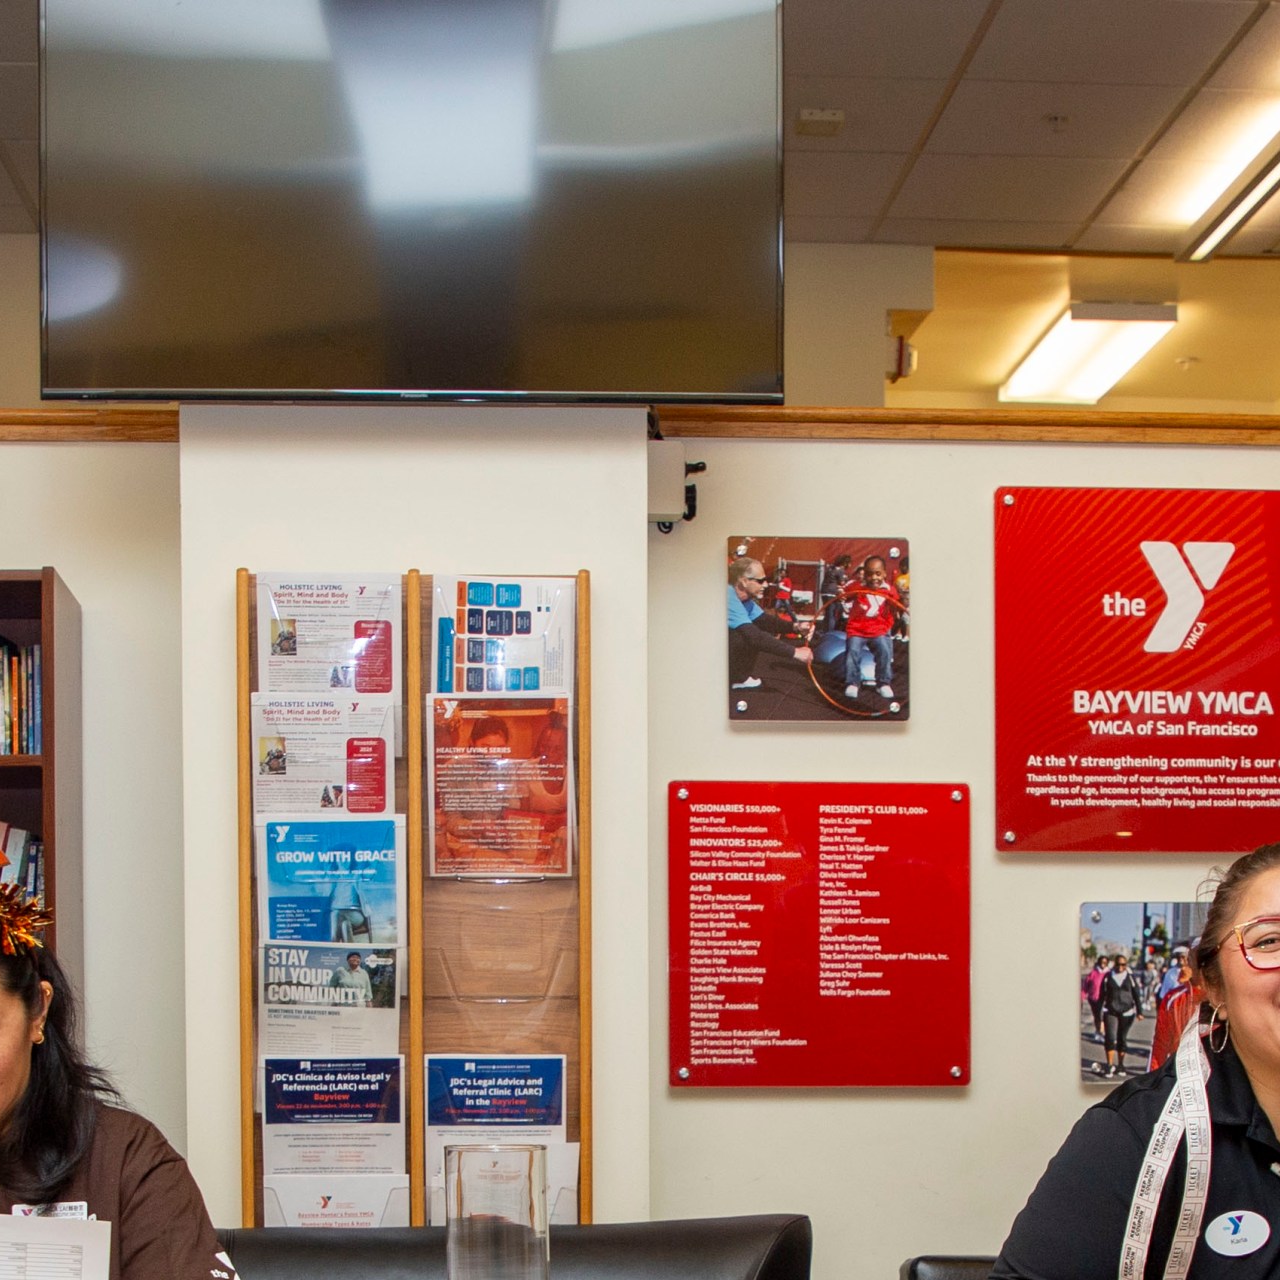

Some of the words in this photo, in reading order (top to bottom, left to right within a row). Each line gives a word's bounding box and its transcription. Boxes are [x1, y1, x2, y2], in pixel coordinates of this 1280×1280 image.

[1103, 592, 1145, 616] the
[1140, 541, 1235, 653] Y
[1184, 621, 1207, 650] YMCA
[1073, 690, 1192, 714] BAYVIEW
[1197, 691, 1274, 715] YMCA
[1089, 721, 1134, 735] YMCA
[1137, 721, 1154, 735] of
[1157, 721, 1184, 735] San
[1188, 722, 1257, 736] Francisco
[1027, 756, 1042, 766] At
[1045, 756, 1066, 767] the
[1069, 756, 1078, 767] Y
[1081, 756, 1168, 770] strengthening
[1171, 756, 1238, 770] community
[1240, 757, 1251, 768] is
[1254, 759, 1276, 768] our
[1027, 774, 1057, 783] Thanks
[1058, 774, 1068, 783] to
[1069, 774, 1083, 783] the
[1084, 774, 1128, 785] generosity
[1129, 774, 1138, 783] of
[1156, 775, 1202, 786] supporters,
[1204, 775, 1217, 784] the
[1218, 776, 1226, 784] Y
[1227, 776, 1258, 784] ensures
[1260, 776, 1277, 784] that
[1026, 786, 1070, 796] regardless
[1071, 786, 1080, 794] of
[1081, 788, 1098, 796] age,
[1100, 786, 1129, 795] income
[1141, 786, 1191, 797] background,
[1192, 786, 1207, 795] has
[1236, 787, 1245, 795] to
[690, 804, 744, 812] VISIONARIES
[1051, 798, 1059, 806] in
[1060, 798, 1084, 808] youth
[1086, 798, 1140, 808] development,
[1142, 798, 1172, 808] healthy
[1173, 798, 1196, 809] living
[1197, 798, 1212, 807] and
[1213, 798, 1236, 807] social
[819, 805, 874, 814] PRESIDENT'S
[875, 806, 896, 814] CLUB
[898, 807, 928, 815] $1,000+
[276, 851, 314, 863] GROW
[318, 851, 350, 862] WITH
[355, 850, 395, 861] GRACE
[690, 873, 723, 881] CHAIR'S
[725, 873, 753, 881] CIRCLE
[269, 948, 309, 966] STAY
[269, 967, 285, 983] IN
[268, 985, 365, 1003] COMMUNITY
[272, 1074, 293, 1083] JDC's
[325, 1073, 335, 1081] de
[337, 1073, 360, 1081] Aviso
[362, 1073, 383, 1082] Legal
[450, 1078, 471, 1087] JDC's
[473, 1078, 495, 1087] Legal
[283, 1083, 328, 1091] Referencia
[330, 1083, 357, 1091] (LARC)
[453, 1088, 487, 1096] Referral
[489, 1088, 511, 1096] Clinic
[514, 1088, 542, 1096] (LARC)
[314, 1093, 350, 1101] Bayview
[492, 1098, 527, 1107] Bayview
[210, 1269, 229, 1279] the
